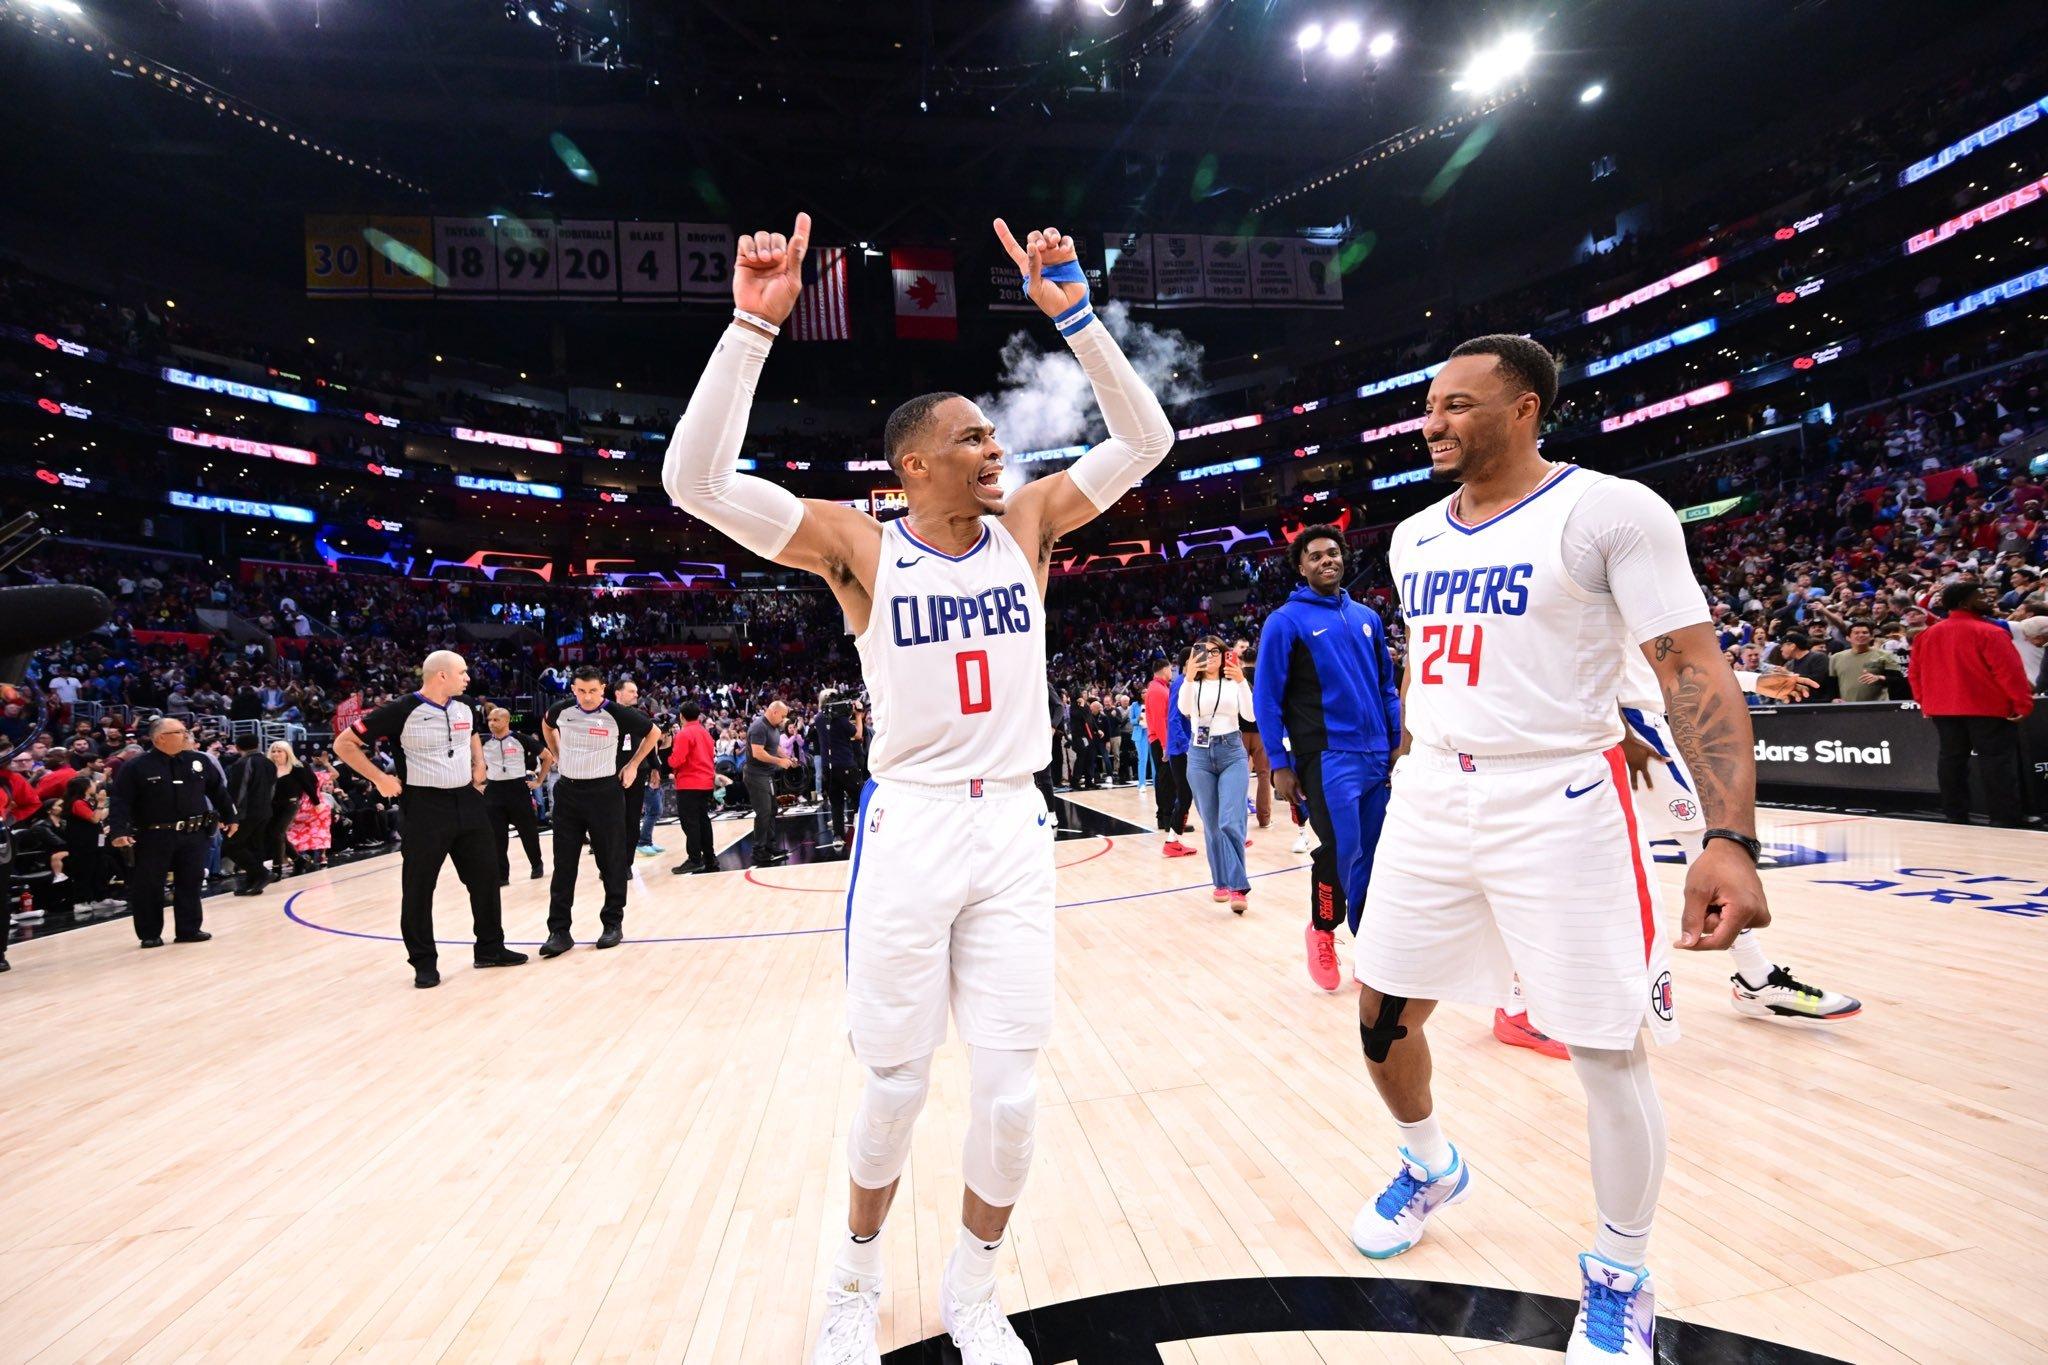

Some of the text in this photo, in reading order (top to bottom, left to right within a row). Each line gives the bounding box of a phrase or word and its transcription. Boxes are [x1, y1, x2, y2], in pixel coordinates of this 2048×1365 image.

[1904, 102, 2040, 184] CLIPPERS
[446, 226, 485, 238] TAYLOR
[1907, 178, 2041, 254] CLIPPERS
[630, 231, 665, 243] BLAKE
[687, 231, 727, 244] BROWN
[313, 243, 360, 276] 30
[447, 245, 485, 279] 18
[505, 246, 550, 280] 99
[566, 247, 610, 281] 20
[637, 250, 659, 281] 4
[689, 251, 729, 283] 23
[173, 428, 272, 458] CLIPPERS
[170, 491, 271, 517] CLIPPERS
[1402, 563, 1533, 618] CLIPPERS
[892, 583, 1031, 647] CLIPPERS
[1422, 625, 1484, 686] 24
[956, 649, 992, 715] 0
[1754, 741, 1891, 764] dars Sinai
